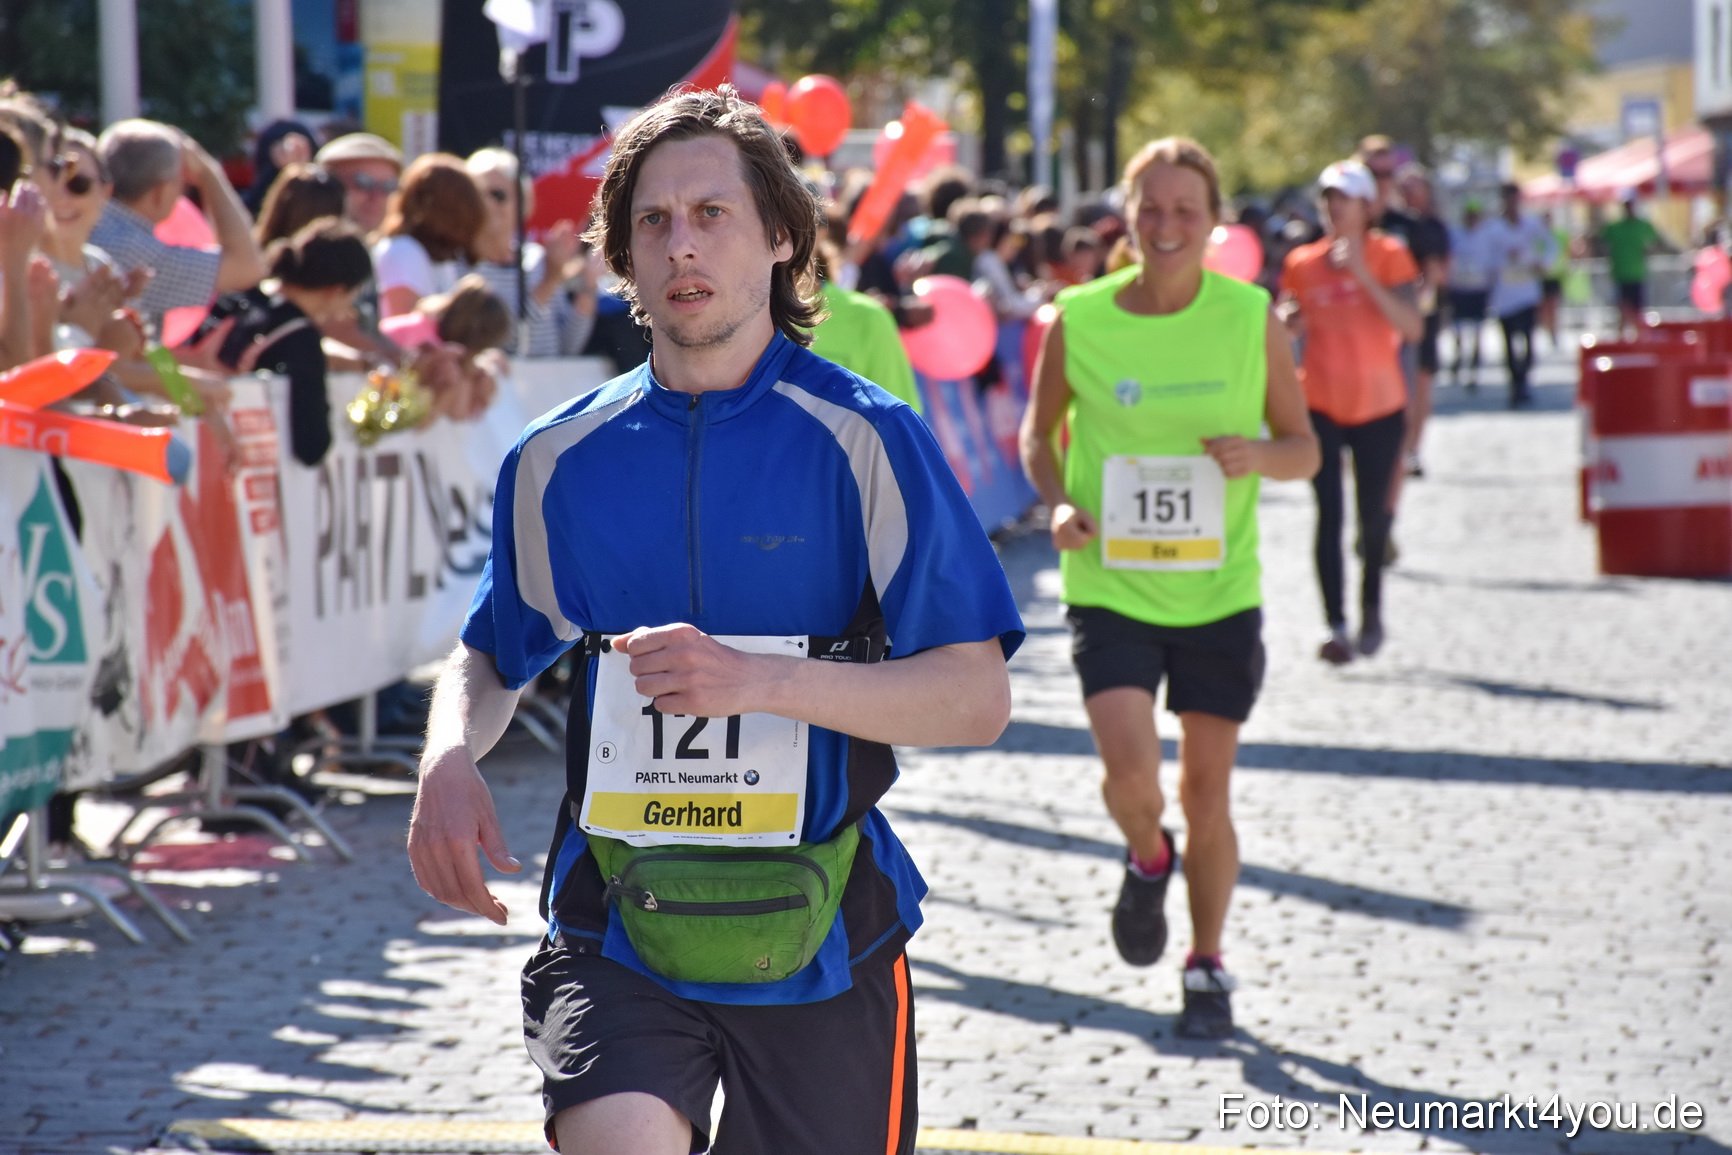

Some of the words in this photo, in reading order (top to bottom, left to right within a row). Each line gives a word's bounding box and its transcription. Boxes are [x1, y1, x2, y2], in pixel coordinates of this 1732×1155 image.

[1134, 488, 1192, 522] 151
[602, 746, 610, 759] B
[635, 772, 676, 784] PARTL
[678, 772, 739, 784] Neumarkt
[643, 800, 742, 827] Gerhard
